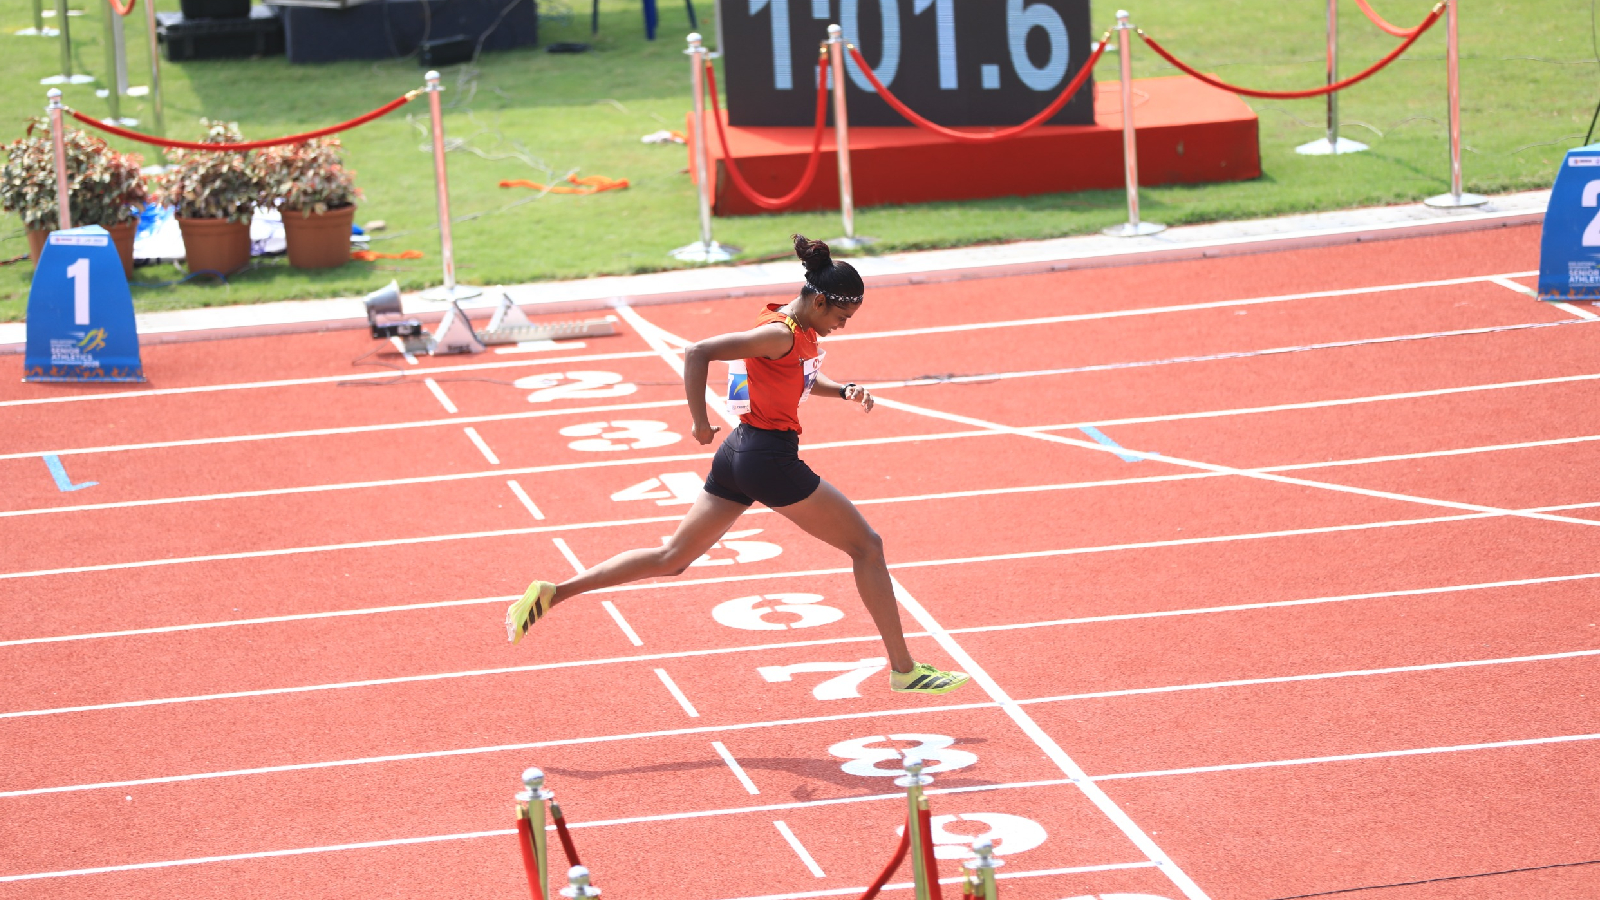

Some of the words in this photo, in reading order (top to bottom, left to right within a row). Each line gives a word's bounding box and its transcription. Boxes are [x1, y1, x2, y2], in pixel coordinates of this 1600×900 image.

[66, 258, 90, 325] 1
[513, 370, 638, 403] 2
[559, 419, 684, 452] 3
[711, 592, 845, 631] 6
[756, 657, 889, 701] 7
[827, 733, 979, 777] 8
